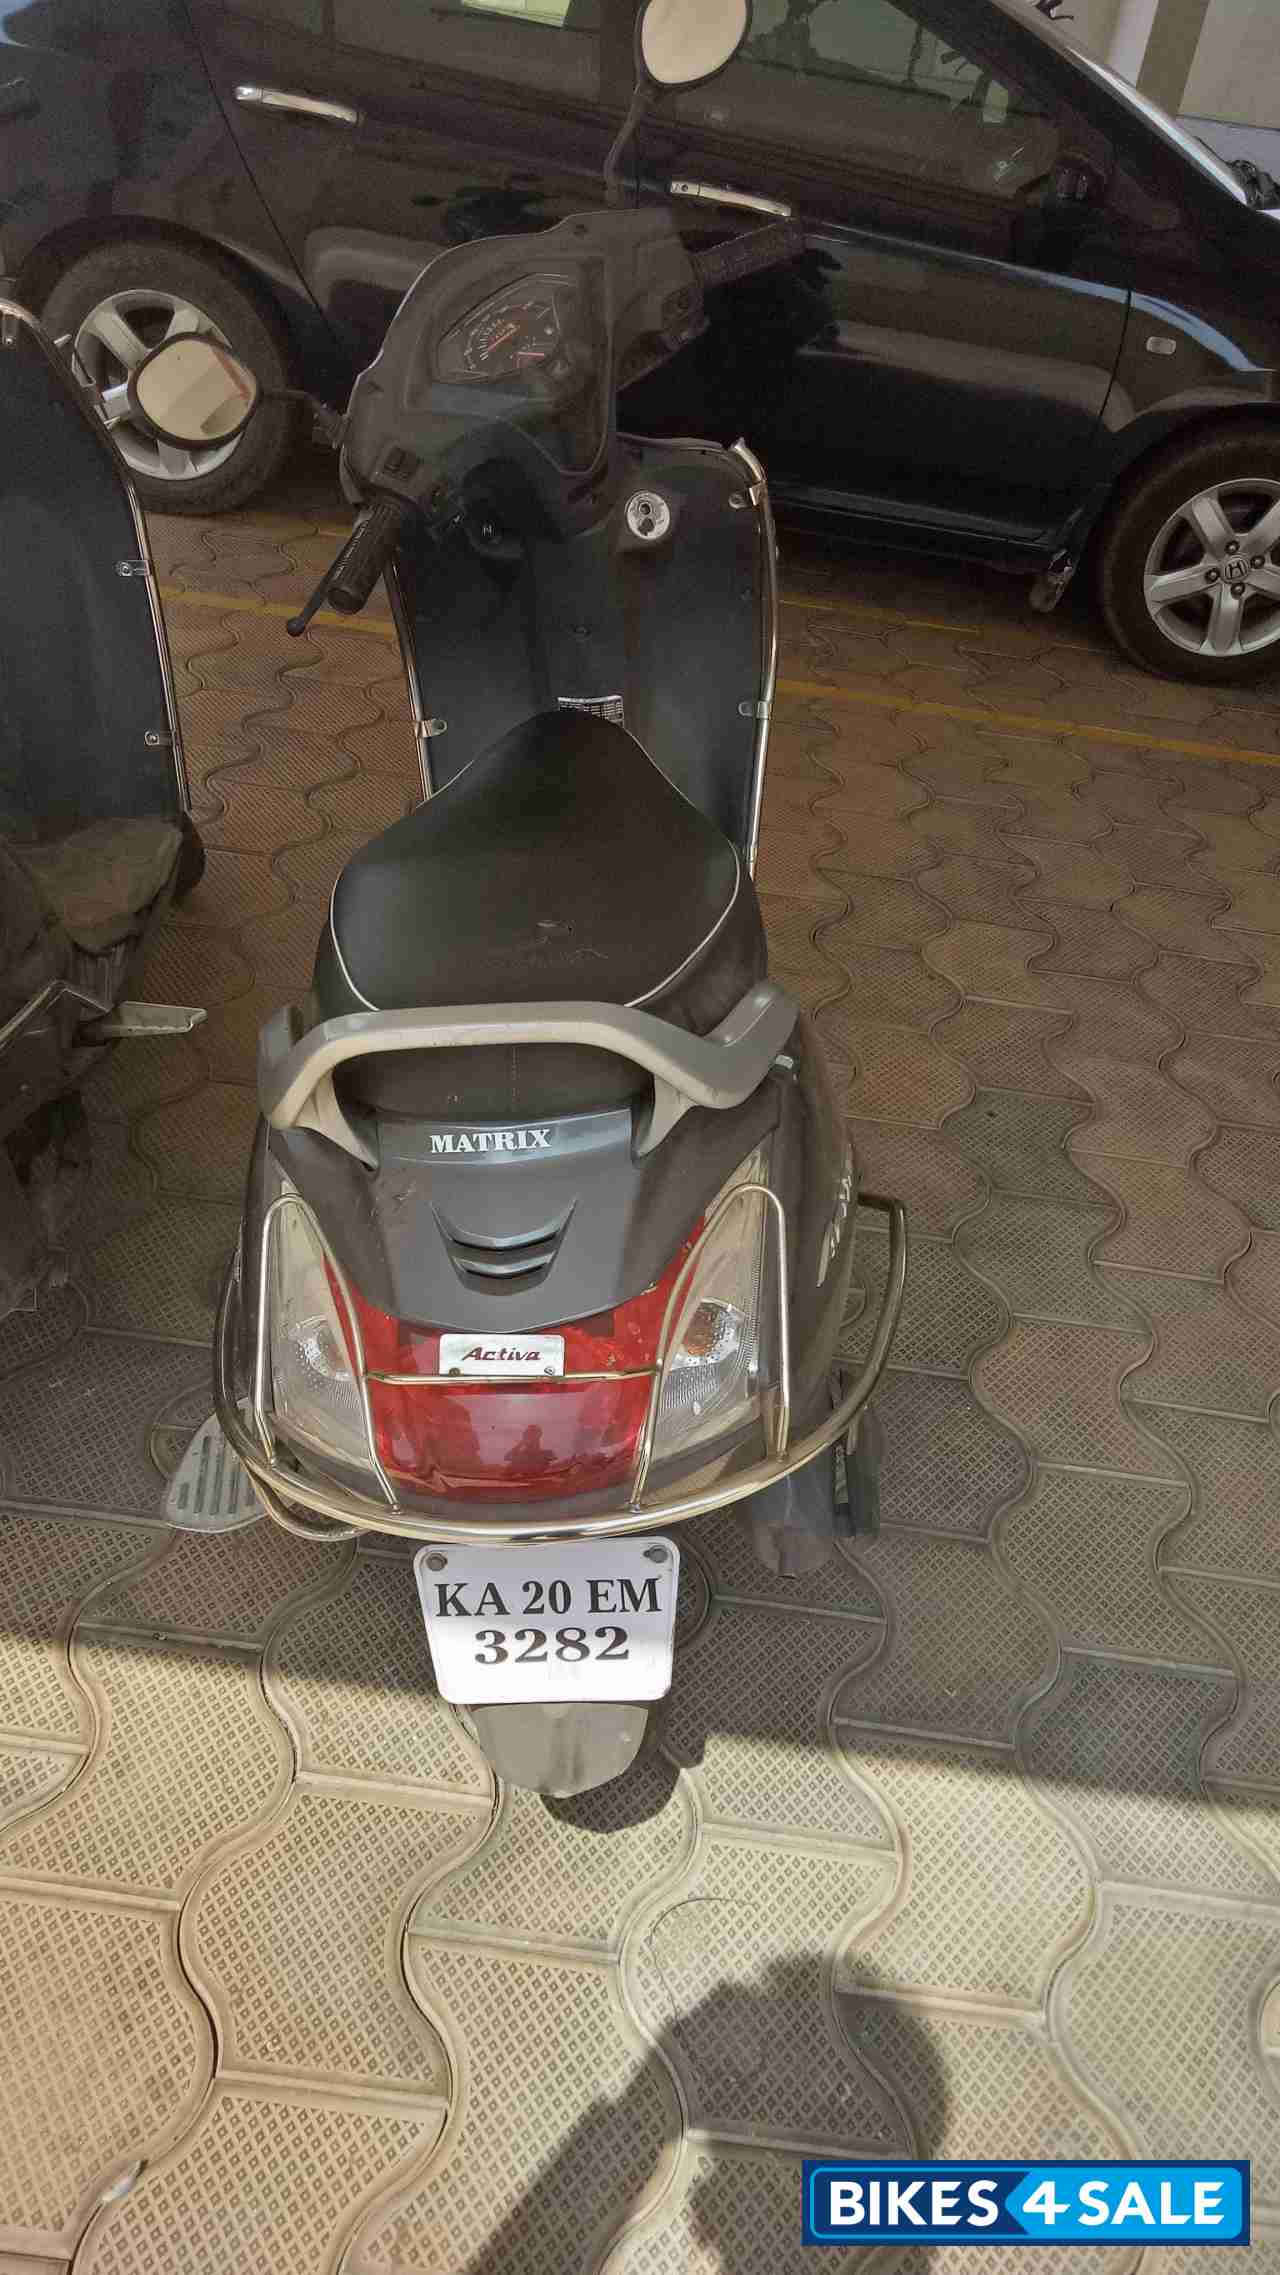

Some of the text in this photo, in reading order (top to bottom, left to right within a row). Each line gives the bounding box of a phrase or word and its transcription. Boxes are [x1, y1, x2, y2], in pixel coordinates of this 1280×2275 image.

[429, 1129, 551, 1153] MATRIX
[462, 1346, 541, 1361] Activa
[434, 1577, 662, 1617] KA 20 EM
[474, 1626, 630, 1664] 3282
